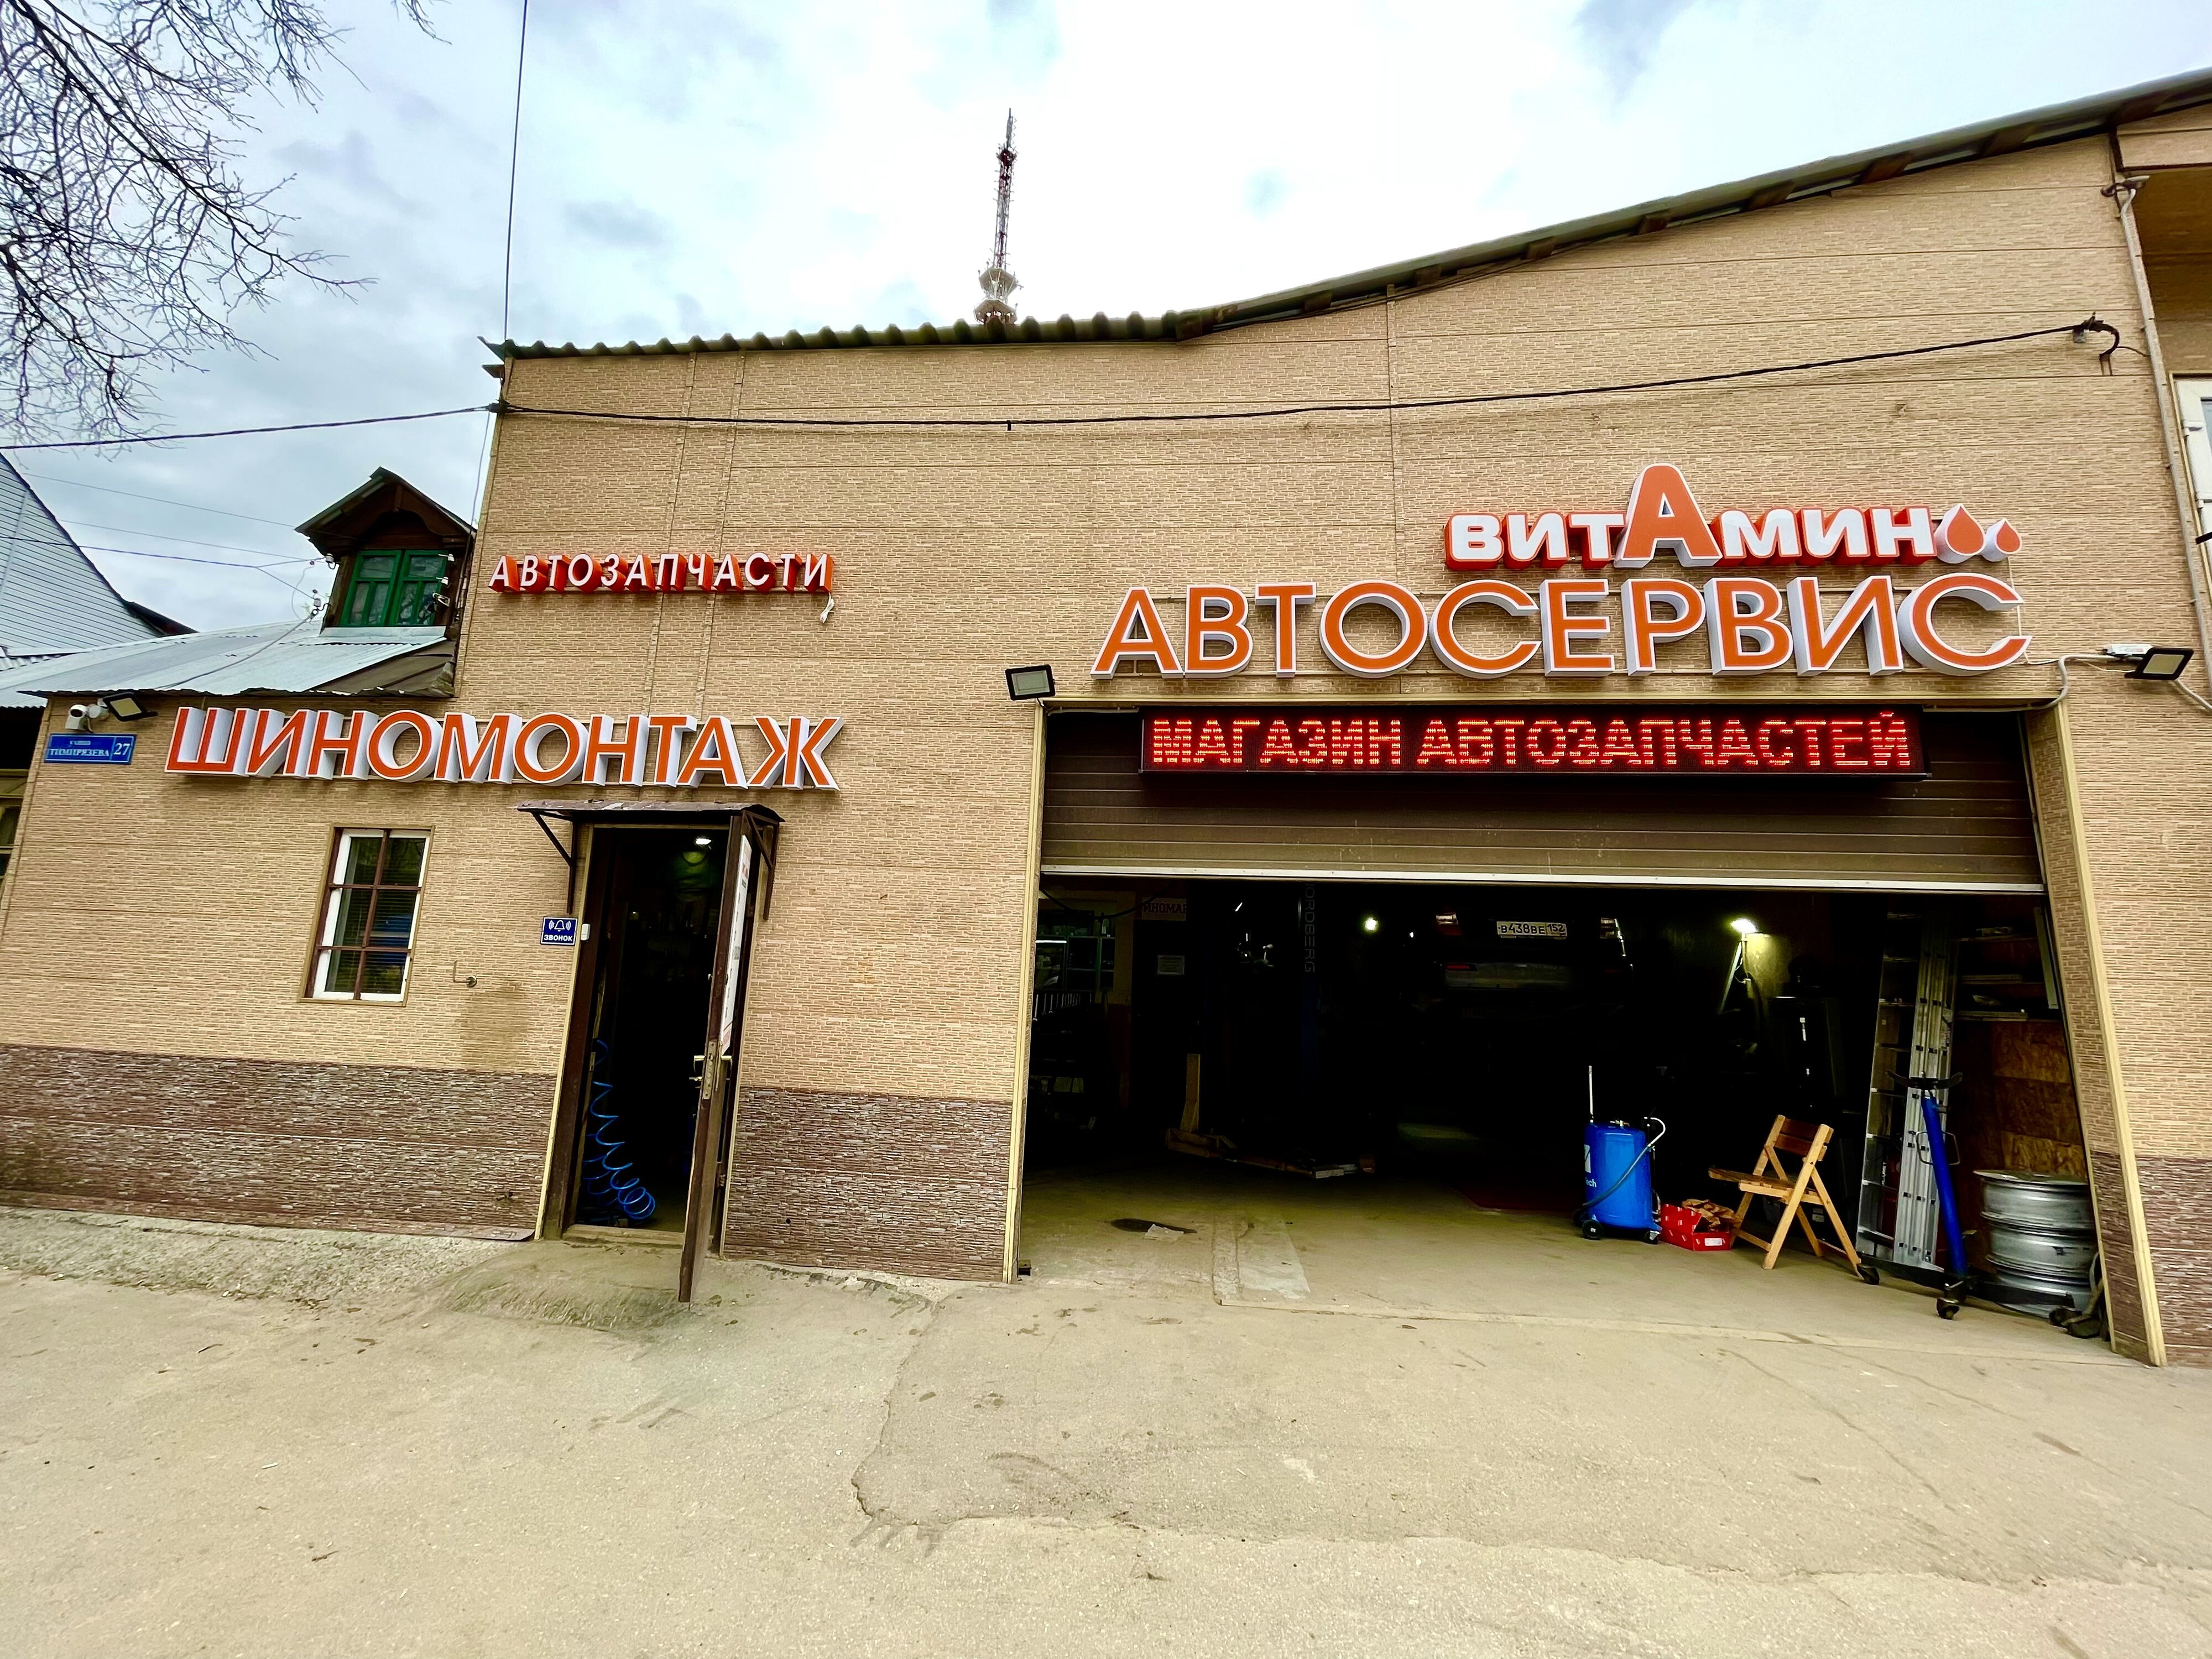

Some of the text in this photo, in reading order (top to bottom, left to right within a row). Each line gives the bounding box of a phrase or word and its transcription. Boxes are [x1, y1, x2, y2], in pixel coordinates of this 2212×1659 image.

[488, 552, 833, 592] АВТОЗАПЧАСТИ
[1090, 572, 2032, 679] АВТОСЕРВИС
[114, 743, 131, 755] 27
[165, 706, 843, 791] ШИНОМОНТАЖ
[1152, 711, 1911, 766] МАГАЗИН АВТОЗАПЧАСТЕЙ
[1305, 884, 1315, 973] ORDBERG
[1547, 924, 1563, 932] 152
